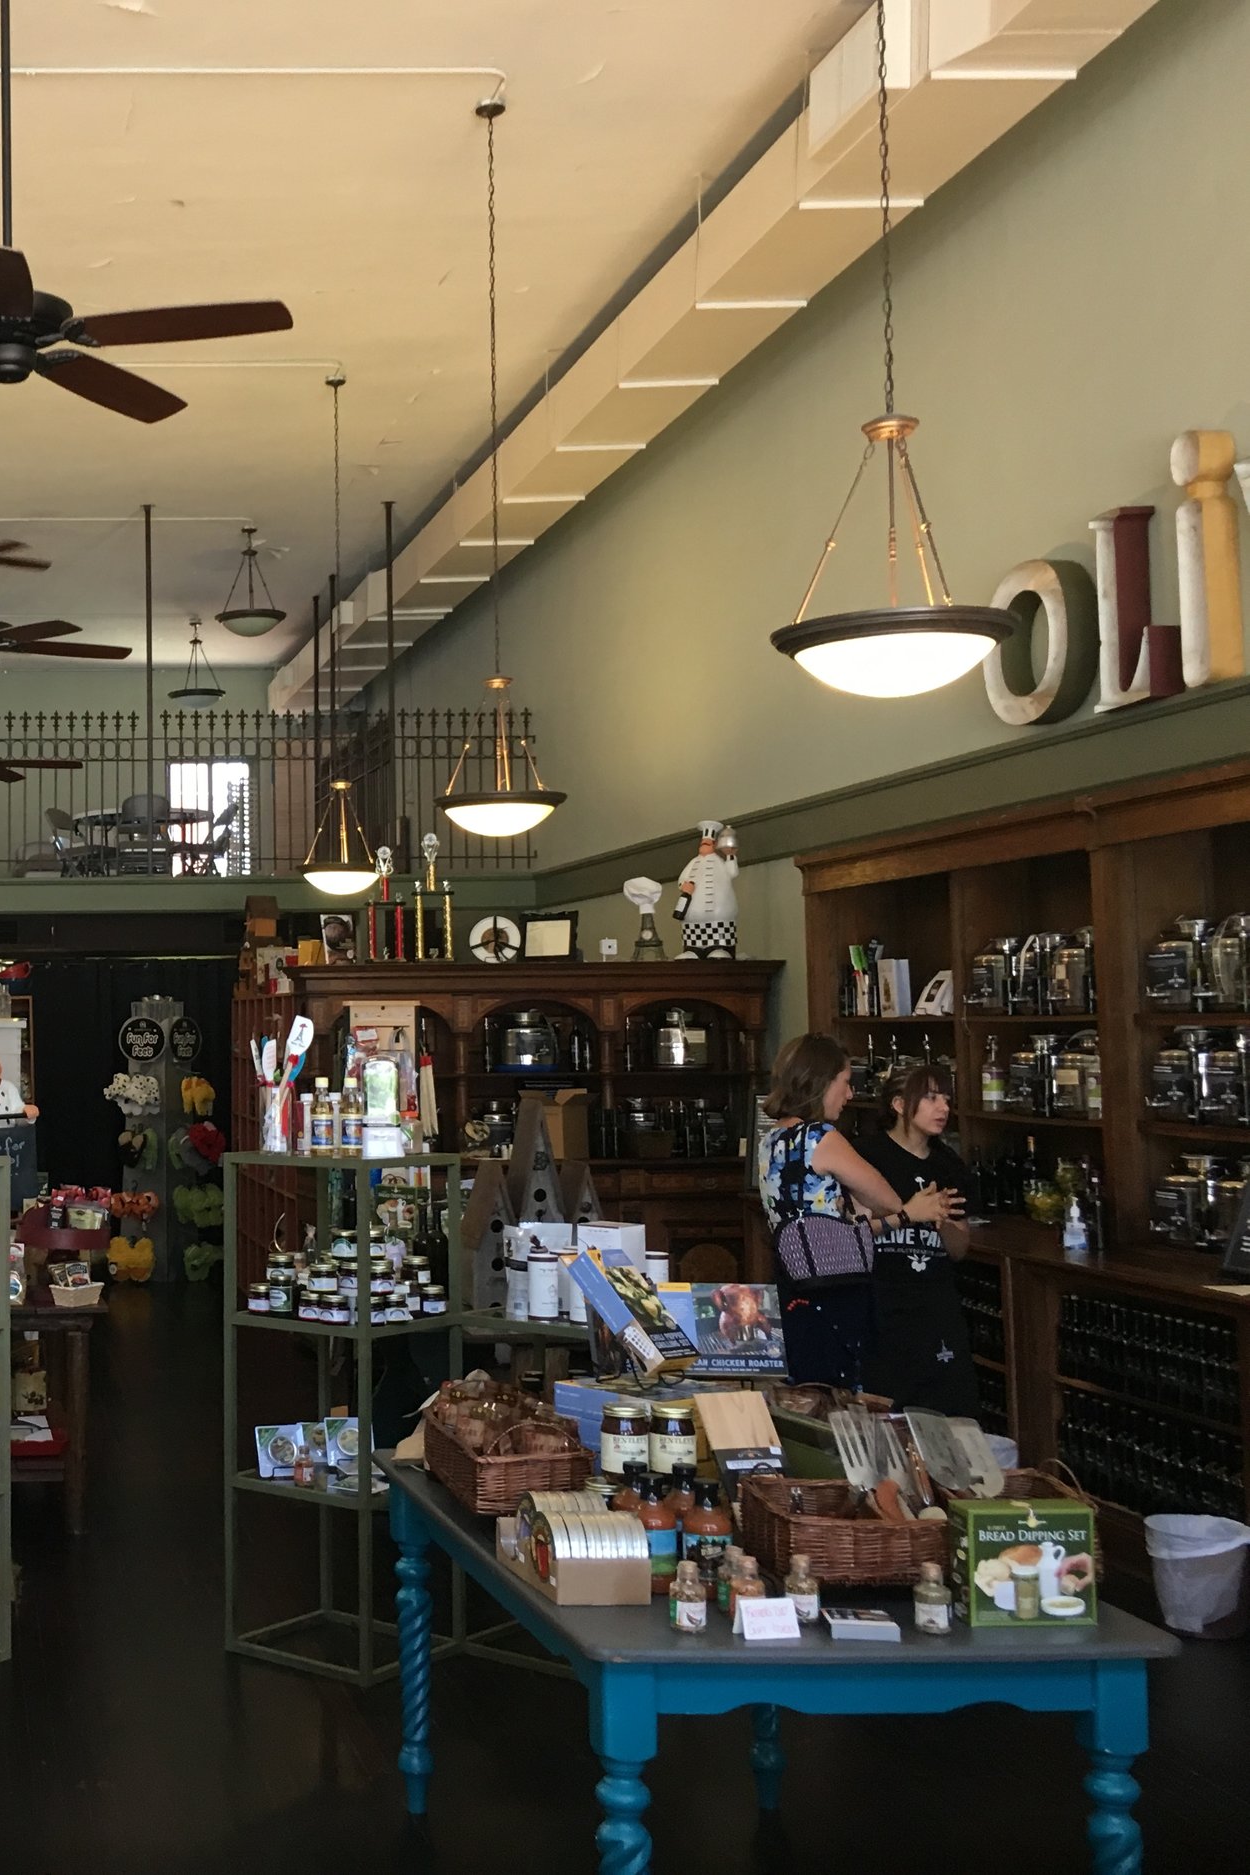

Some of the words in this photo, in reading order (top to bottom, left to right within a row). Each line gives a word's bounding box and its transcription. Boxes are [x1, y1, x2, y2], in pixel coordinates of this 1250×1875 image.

[711, 1358, 746, 1367] CHICKEN
[748, 1359, 784, 1368] ROASTER
[978, 1529, 1015, 1541] BREAD
[1018, 1529, 1065, 1541] DIPPING
[1068, 1529, 1087, 1541] SET
